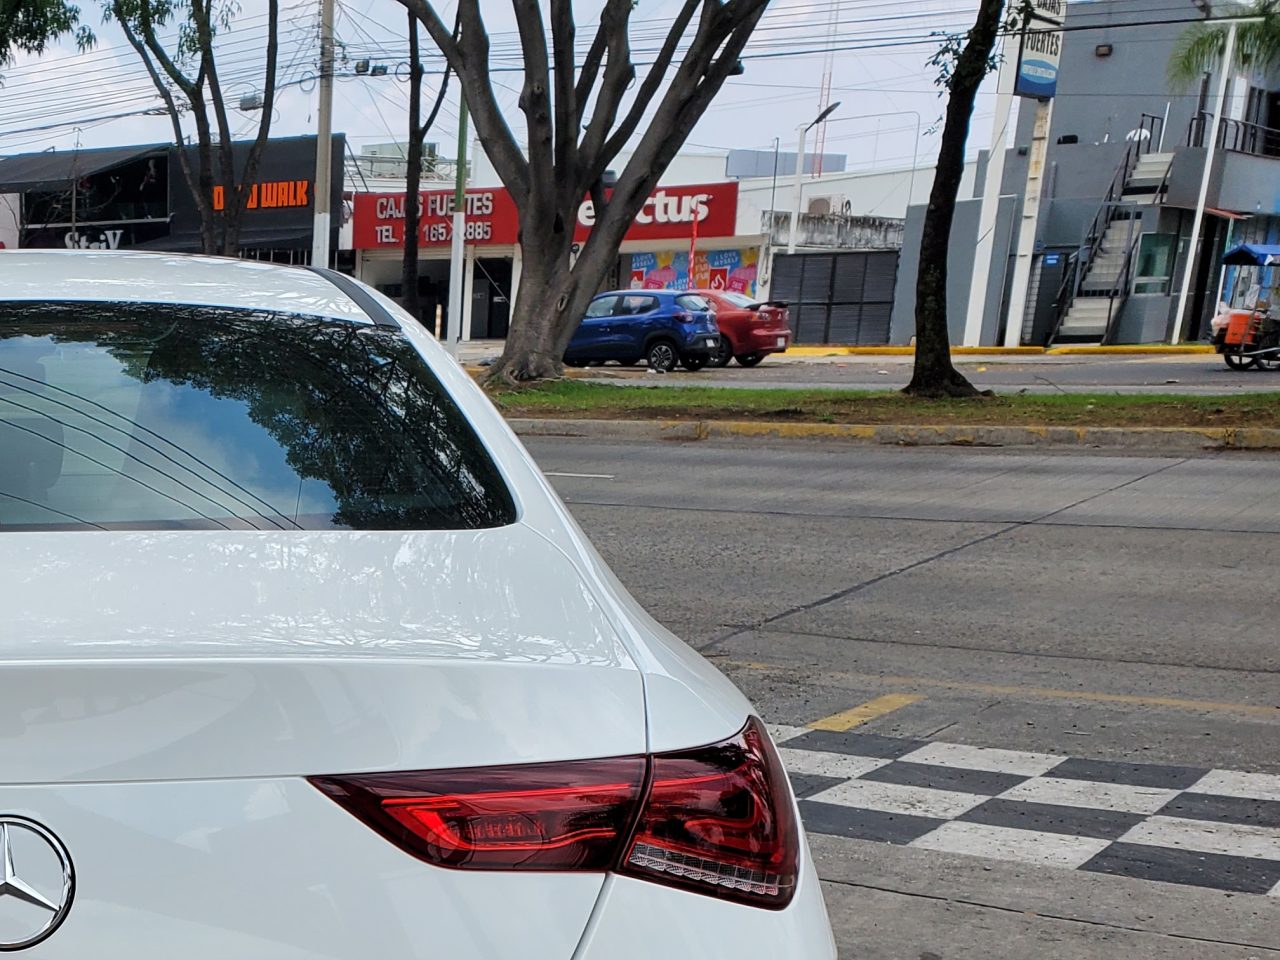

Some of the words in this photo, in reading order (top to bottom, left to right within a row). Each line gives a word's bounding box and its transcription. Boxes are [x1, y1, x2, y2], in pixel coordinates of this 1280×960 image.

[1025, 31, 1060, 57] FUERTES
[261, 181, 308, 208] WALK
[376, 197, 423, 219] CAJS
[428, 193, 493, 217] FUETES
[375, 225, 399, 243] TEL.
